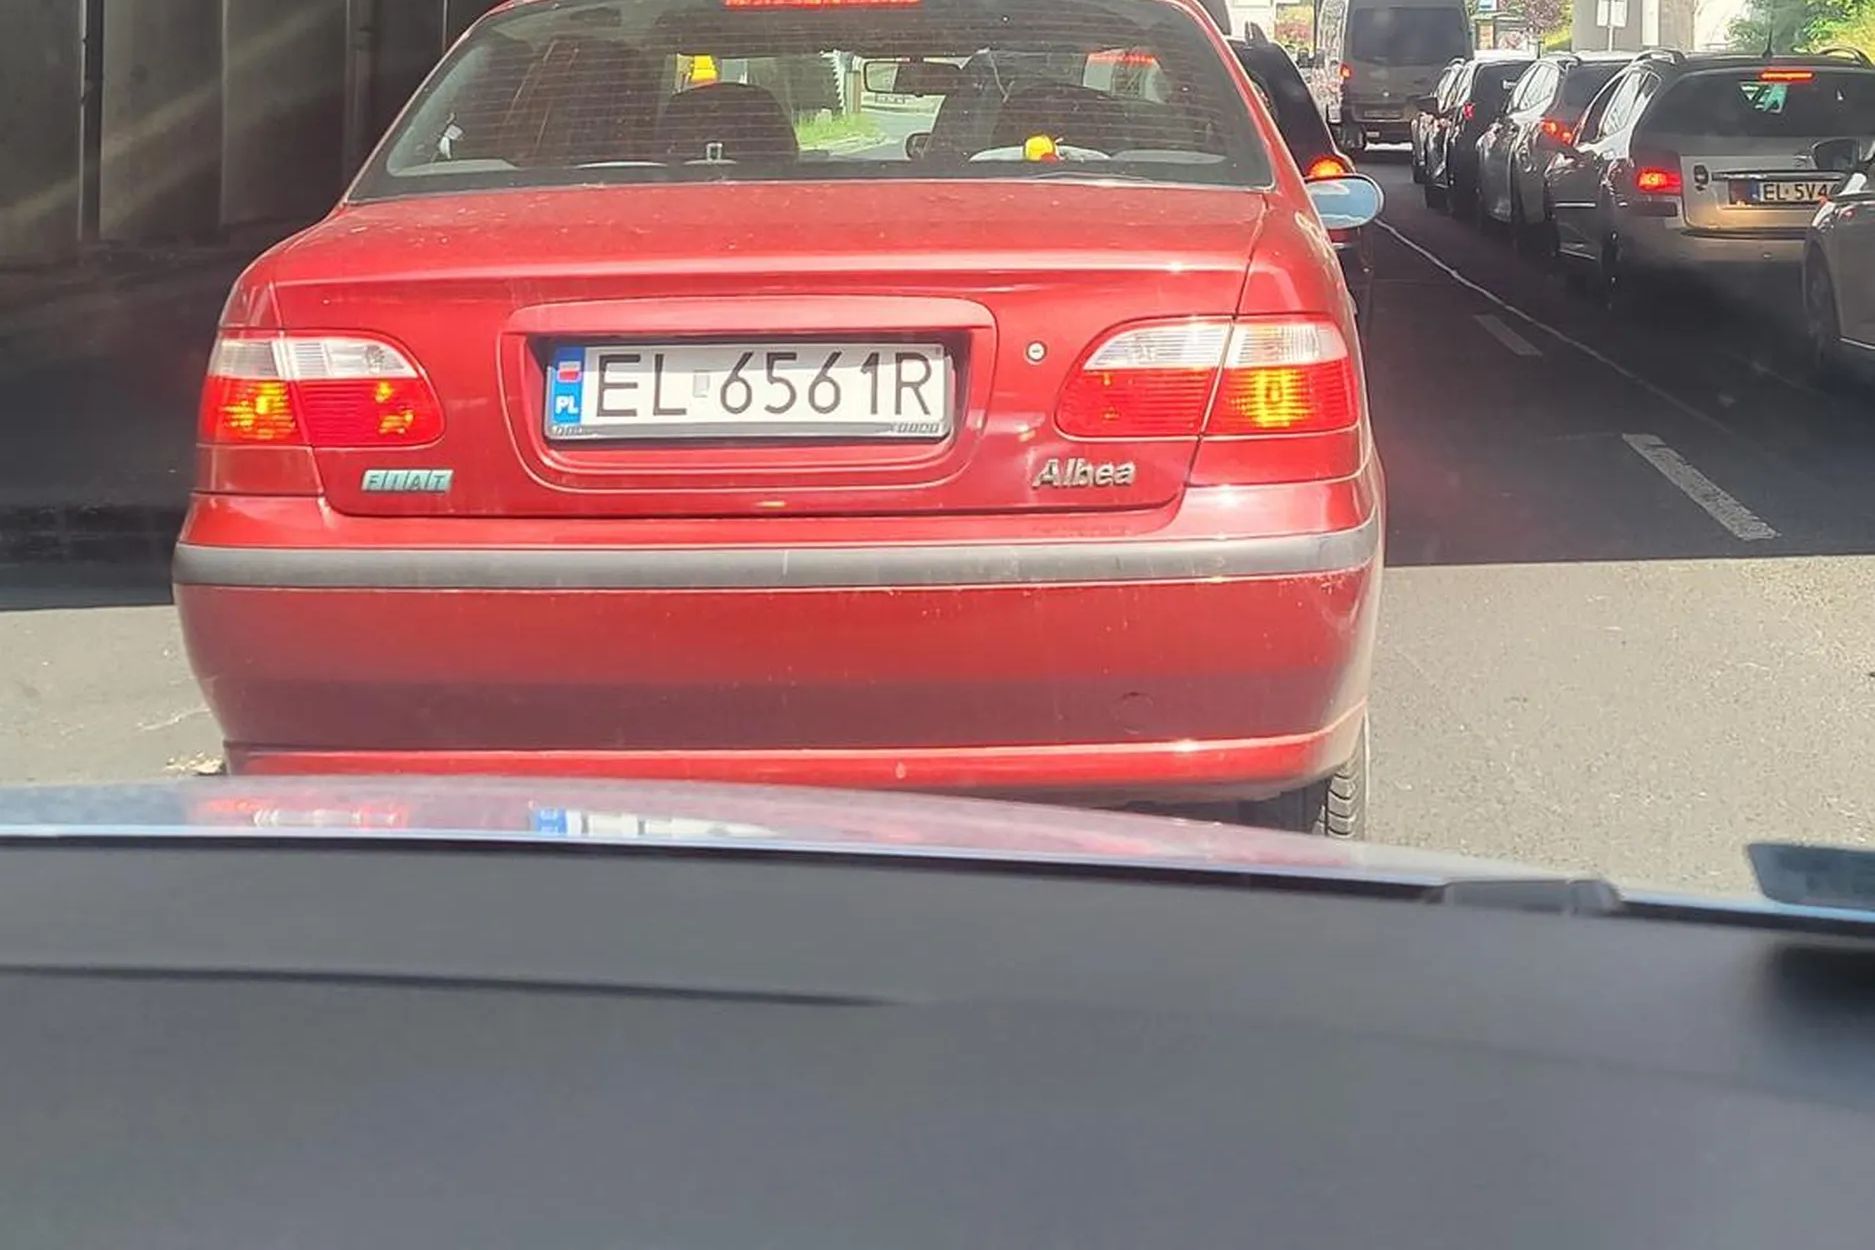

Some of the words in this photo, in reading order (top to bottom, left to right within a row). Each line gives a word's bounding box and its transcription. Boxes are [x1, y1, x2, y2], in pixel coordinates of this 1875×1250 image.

[1763, 183, 1786, 201] EL
[596, 353, 687, 417] EL
[720, 351, 932, 416] 6561R
[555, 395, 580, 414] PL
[364, 471, 450, 491] FIAT
[1031, 457, 1135, 488] Albea
